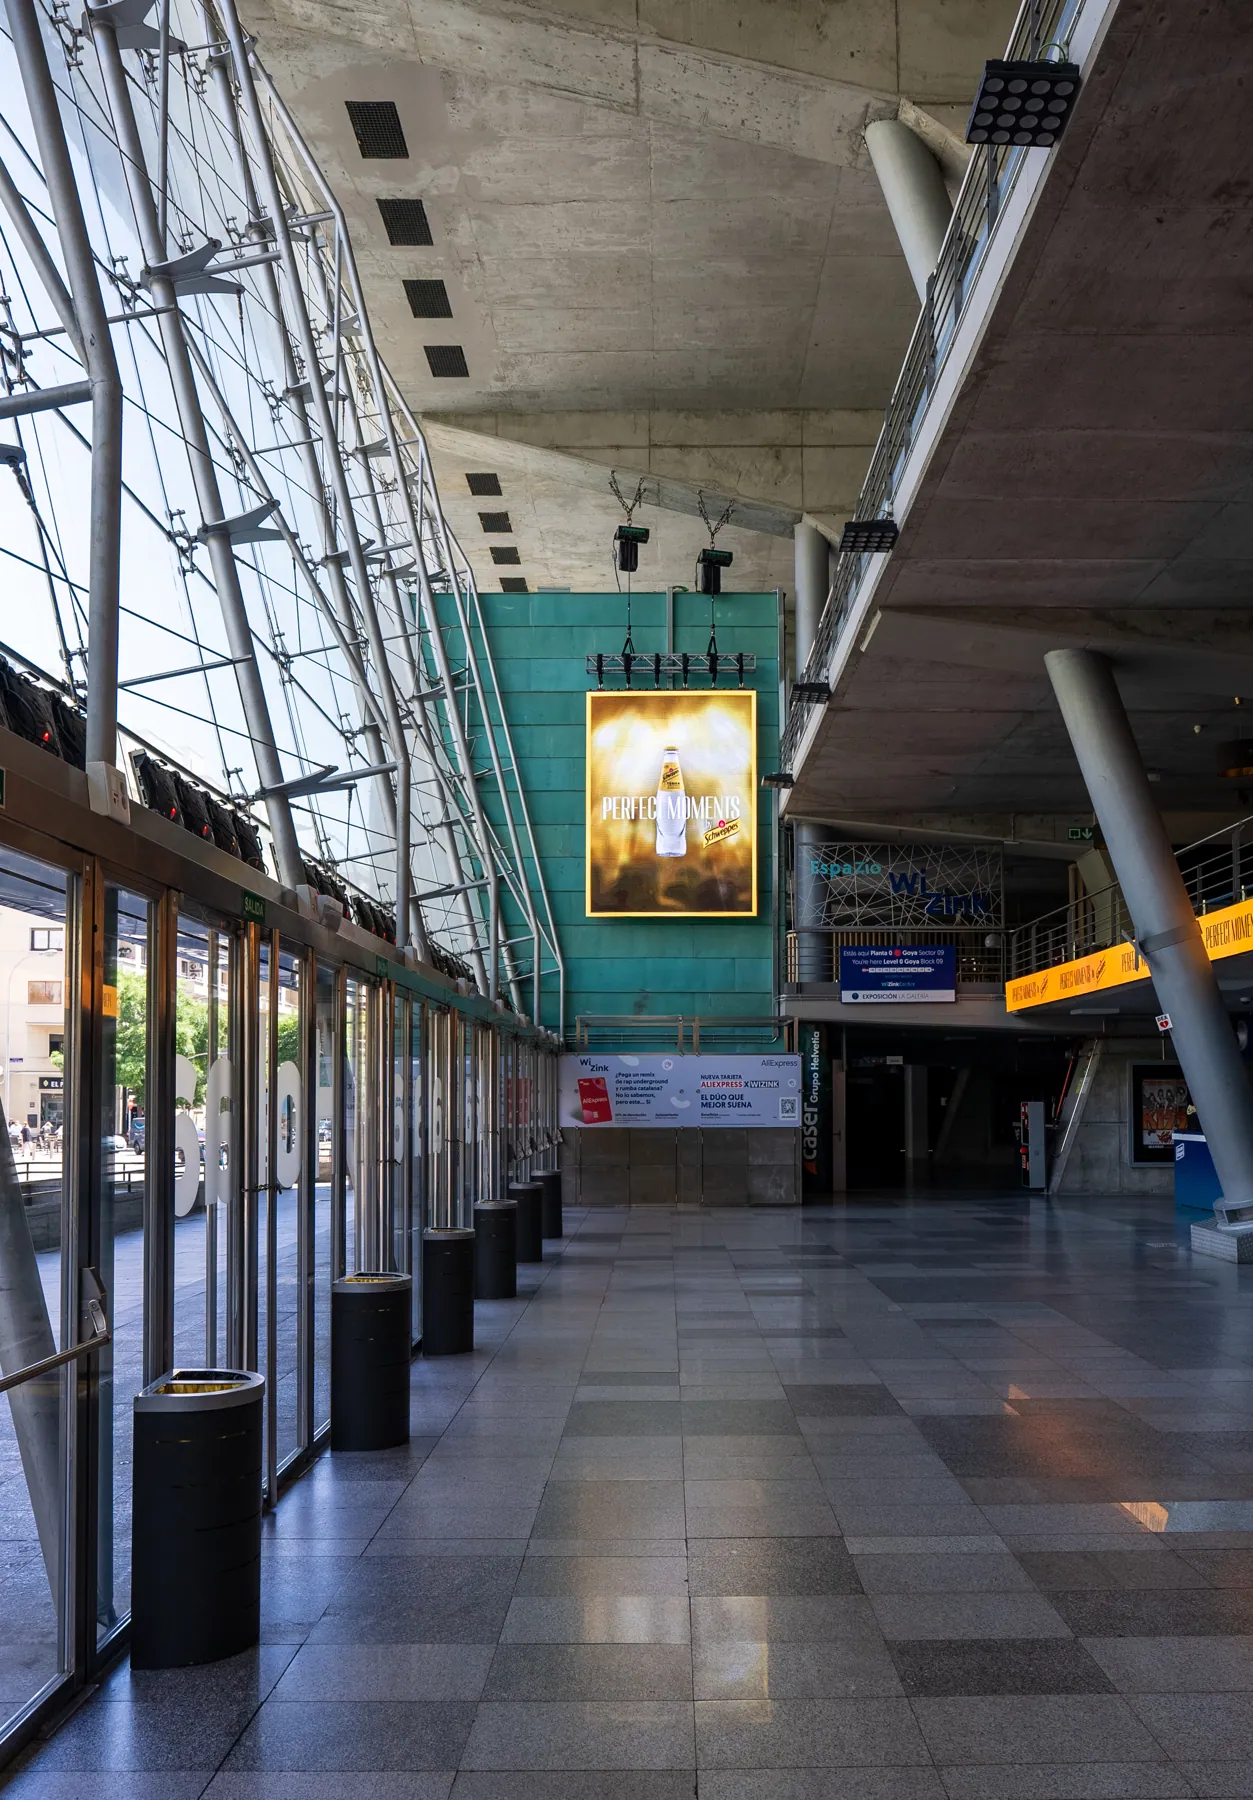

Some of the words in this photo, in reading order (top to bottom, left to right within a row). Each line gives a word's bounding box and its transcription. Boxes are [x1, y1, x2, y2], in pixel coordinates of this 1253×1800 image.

[668, 796, 740, 820] MOMENTS
[704, 822, 738, 845] Schweppes
[244, 896, 264, 918] SALIDA
[1206, 920, 1230, 949] PERFECT
[811, 1031, 820, 1070] Helvetia
[761, 1060, 798, 1068] AliExpress
[810, 1072, 821, 1103] Grupo
[803, 1102, 818, 1160] caser
